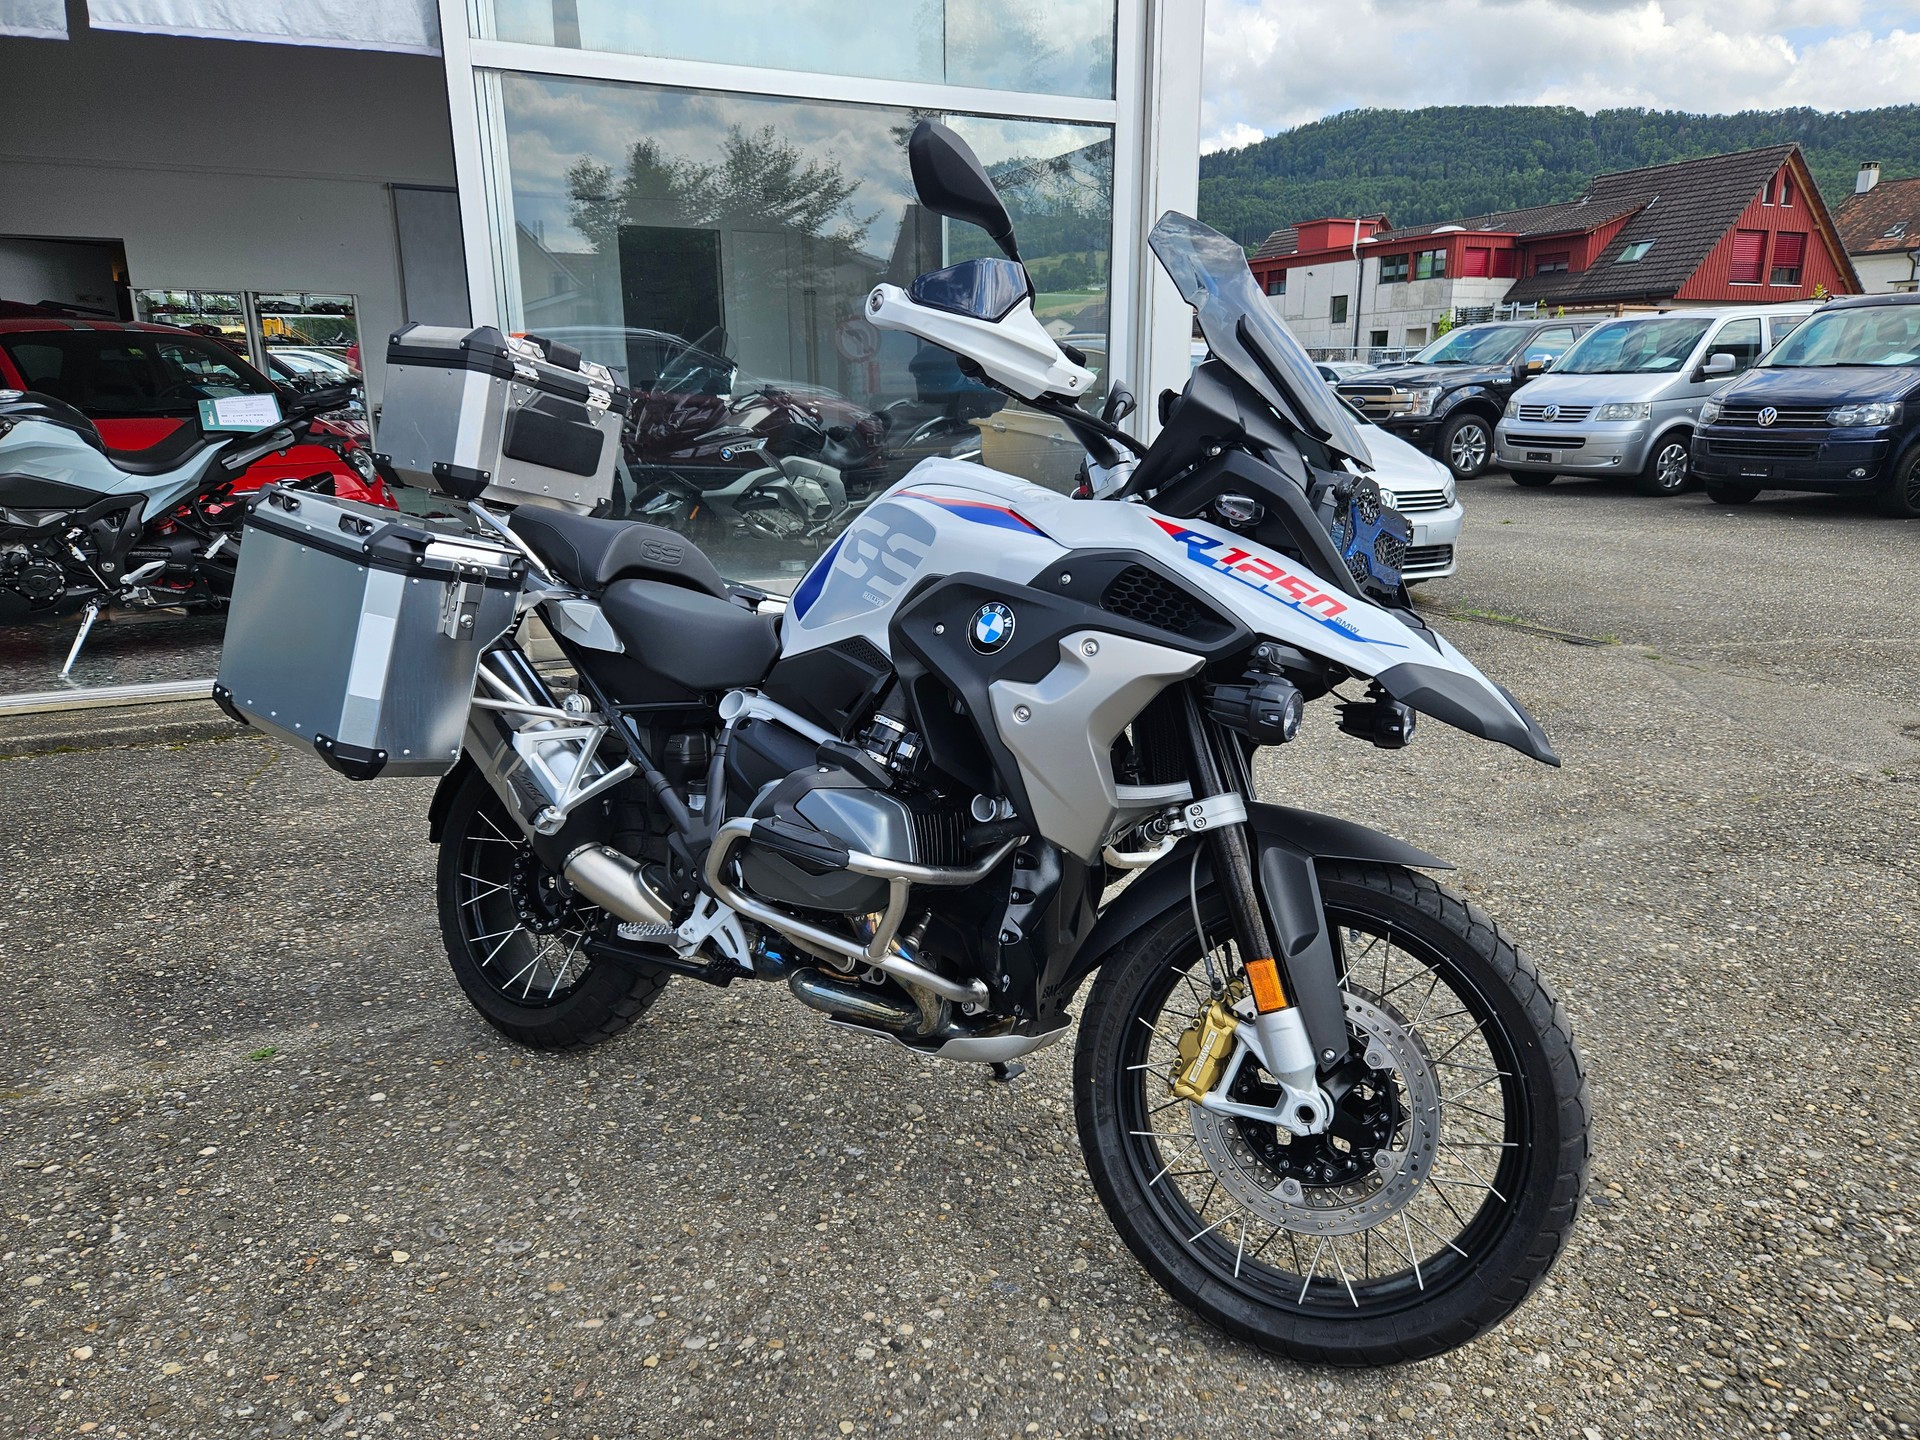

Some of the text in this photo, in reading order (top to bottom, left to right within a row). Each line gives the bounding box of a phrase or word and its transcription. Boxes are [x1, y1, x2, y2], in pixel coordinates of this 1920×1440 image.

[642, 541, 683, 565] GS
[981, 605, 1013, 628] BMW
[1335, 616, 1360, 634] BMW
[1197, 1045, 1210, 1065] BMW
